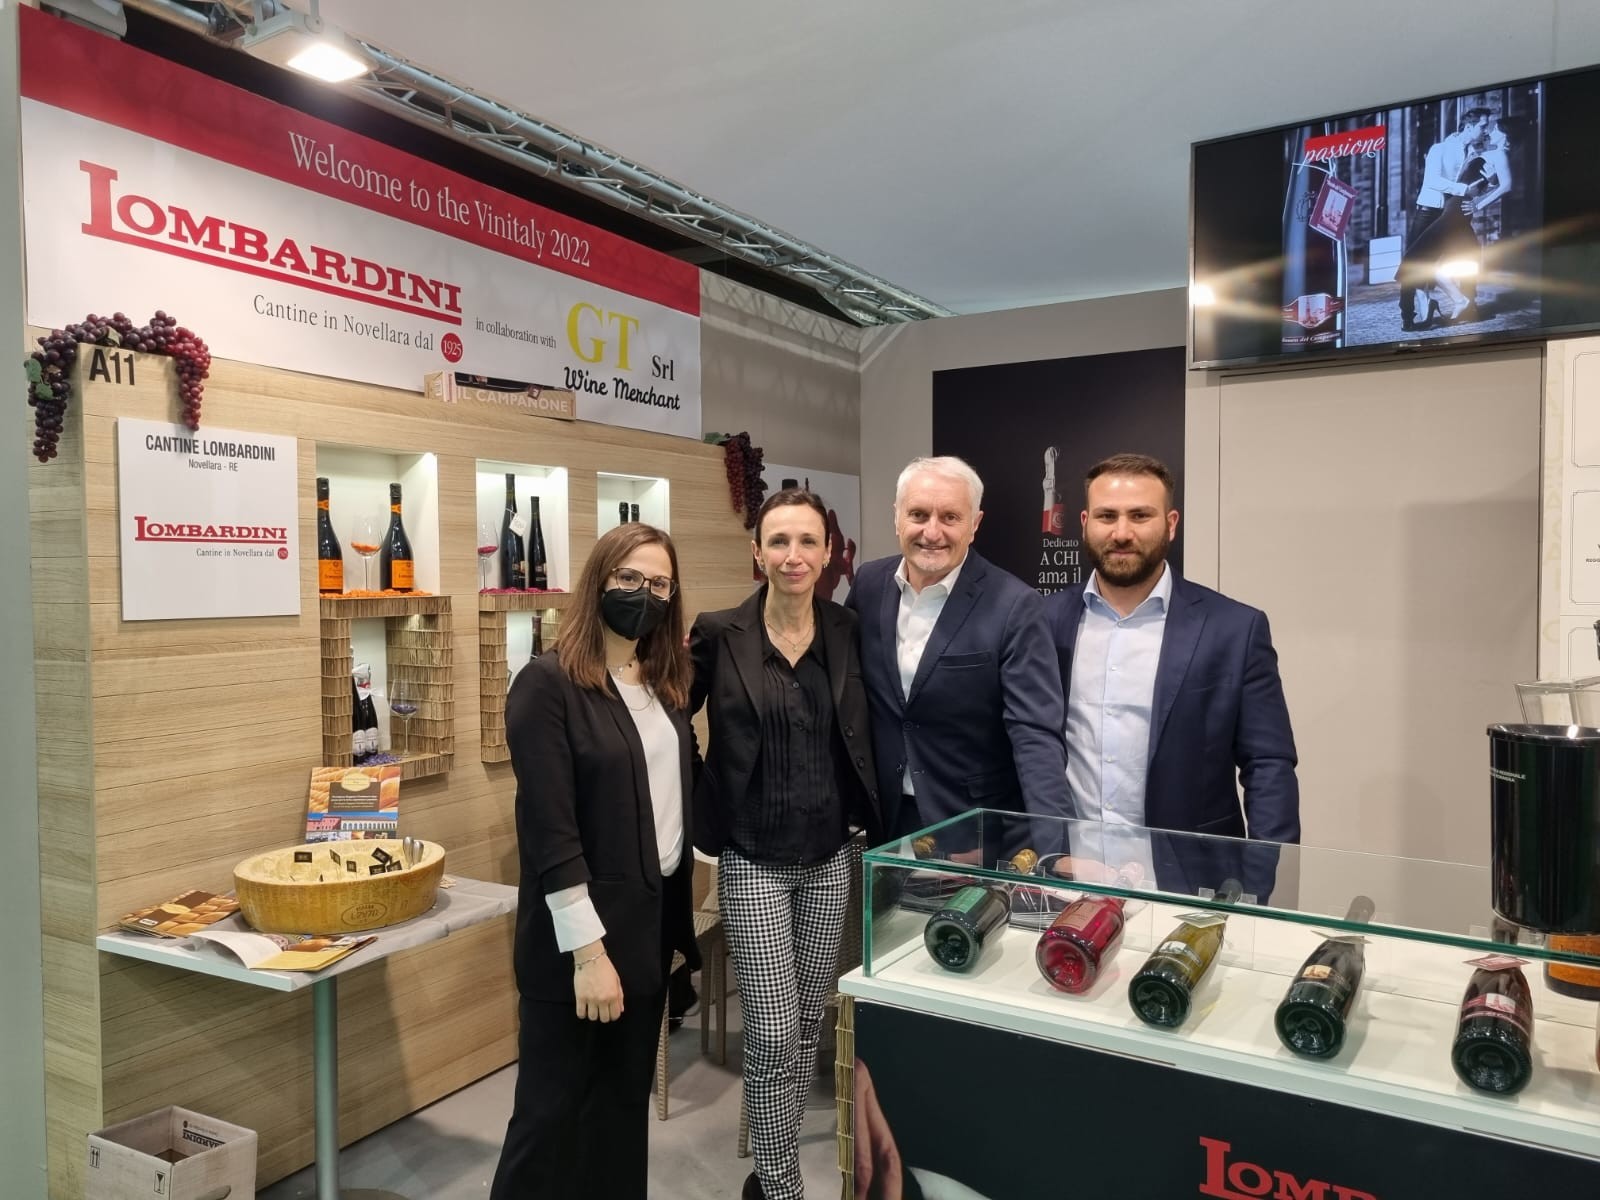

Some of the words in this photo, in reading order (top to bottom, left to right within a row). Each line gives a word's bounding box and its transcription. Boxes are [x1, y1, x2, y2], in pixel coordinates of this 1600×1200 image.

[1297, 136, 1386, 175] passione
[288, 131, 402, 202] Welcome
[409, 180, 430, 212] to
[437, 186, 470, 225] the
[475, 200, 546, 259] Vinitaly
[551, 229, 591, 267] 2022
[79, 160, 462, 314] LOMBARDINI
[253, 294, 319, 326] Cantine
[323, 310, 338, 330] in
[343, 314, 410, 346] Novellara
[414, 330, 434, 351] dal
[476, 317, 485, 332] in
[486, 321, 539, 345] collaboration
[540, 333, 557, 349] with
[443, 339, 463, 356] 1925
[566, 302, 640, 372] GT
[88, 349, 136, 385] A11
[651, 354, 675, 382] Srl
[476, 389, 568, 413] CAMPANONE
[563, 366, 609, 396] Wine
[613, 377, 681, 411] Merchant
[145, 434, 200, 455] CANTINE
[203, 440, 276, 461] LOMBARDINI
[188, 459, 222, 471] Novellara
[229, 462, 239, 471] RE
[134, 516, 288, 541] LOMBARDINI
[196, 548, 223, 557] Cantine
[224, 549, 231, 557] in
[233, 548, 263, 557] Novellara
[265, 549, 275, 557] dal
[1043, 537, 1079, 548] Dedicato
[1040, 551, 1050, 565] A
[1053, 551, 1080, 566] CHI
[1038, 571, 1068, 584] ama
[1073, 567, 1081, 583] il
